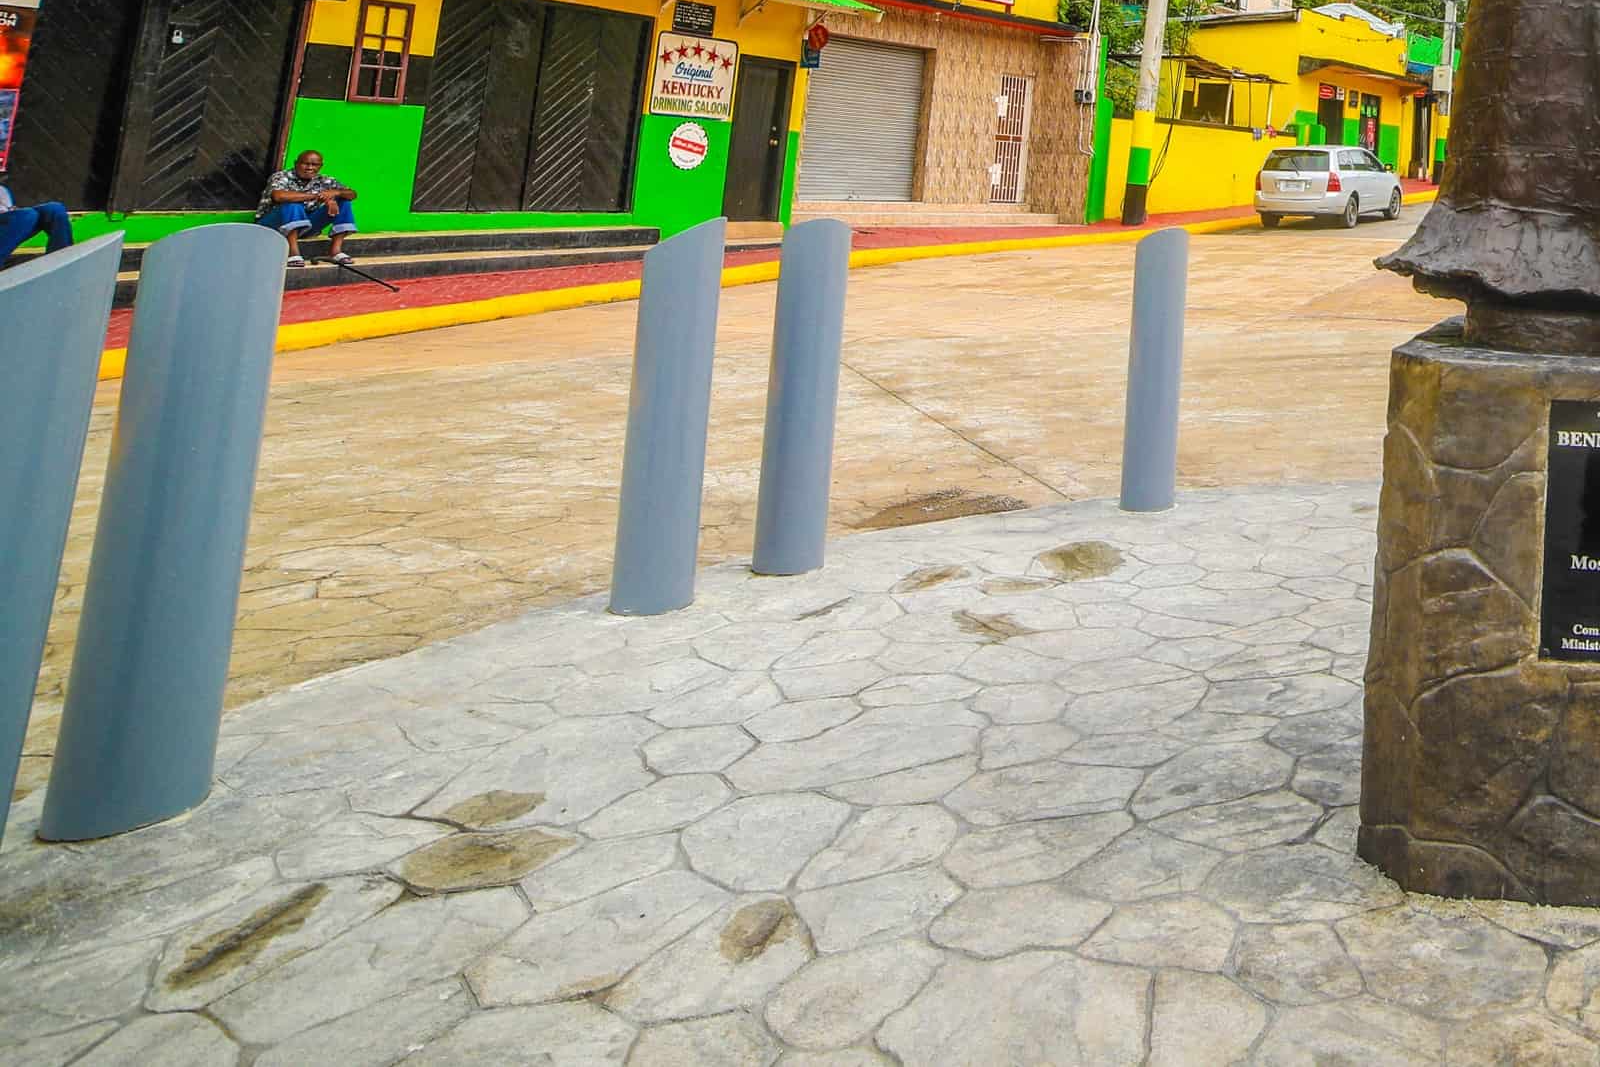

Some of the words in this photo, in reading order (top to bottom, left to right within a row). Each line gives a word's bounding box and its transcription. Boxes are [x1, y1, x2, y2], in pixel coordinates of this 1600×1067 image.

[674, 61, 714, 82] Original
[661, 79, 724, 100] KENTUCKY
[652, 96, 693, 113] DRINKING
[694, 100, 729, 115] SALOON
